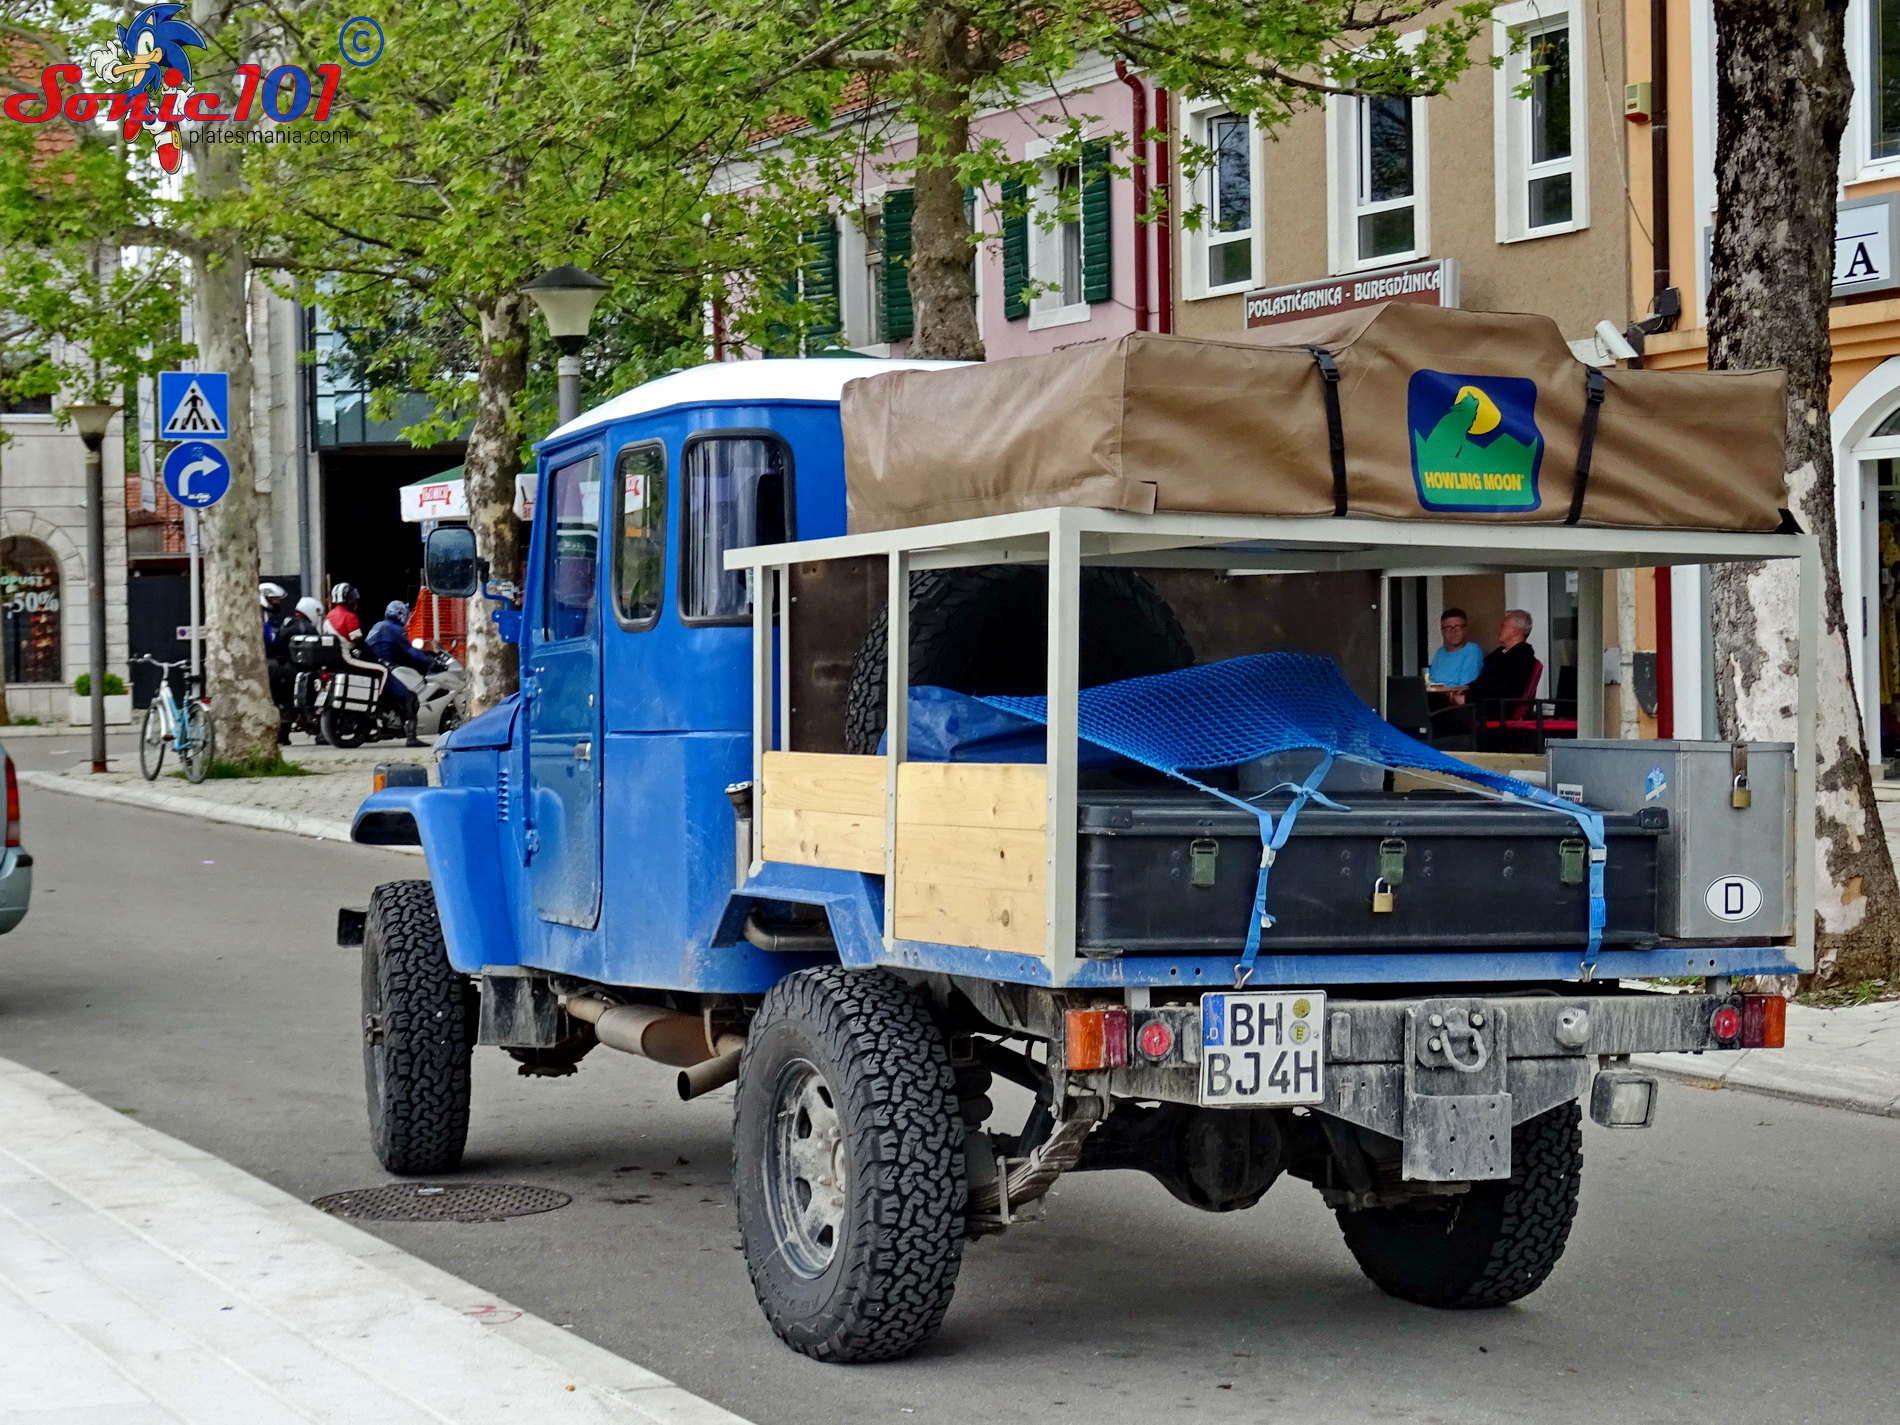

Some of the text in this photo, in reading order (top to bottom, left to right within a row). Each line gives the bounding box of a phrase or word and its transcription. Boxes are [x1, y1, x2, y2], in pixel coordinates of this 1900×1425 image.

[1248, 286, 1342, 319] POSLASTIČARNICA
[1354, 269, 1441, 301] BUREGDŽINICA
[1424, 472, 1482, 490] HOWLING
[1725, 883, 1743, 914] D
[1230, 1002, 1283, 1046] BH
